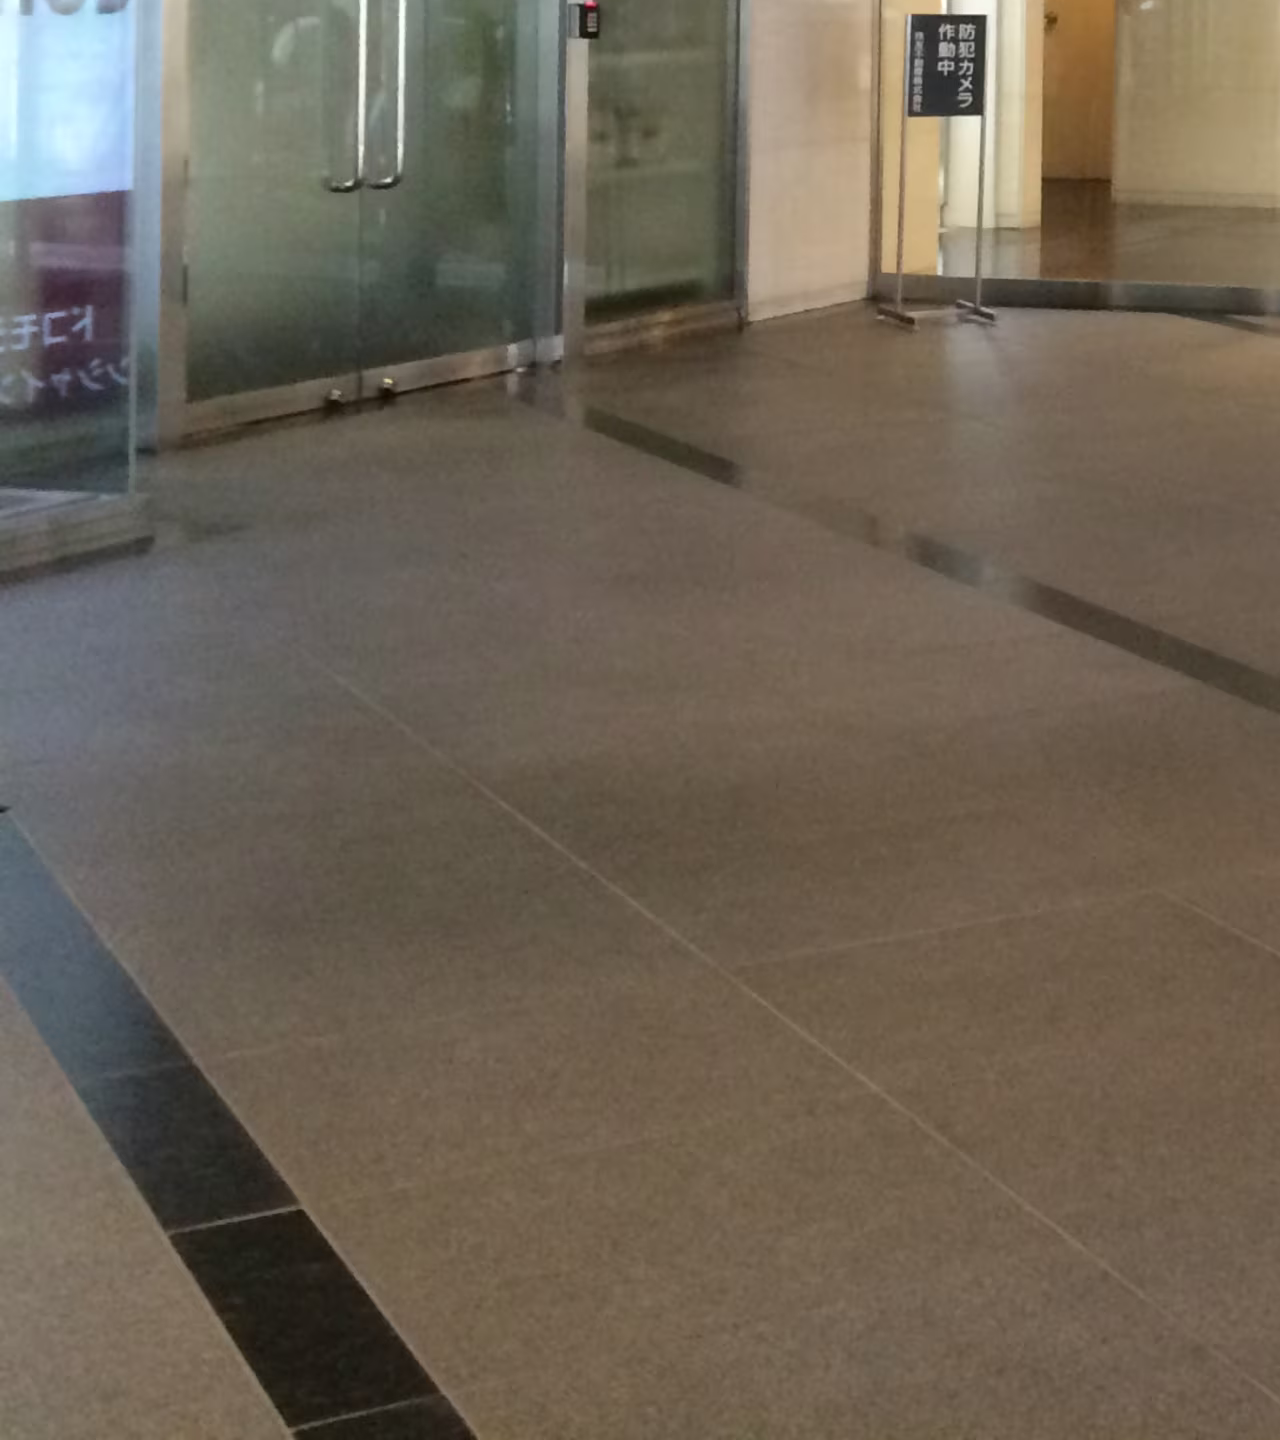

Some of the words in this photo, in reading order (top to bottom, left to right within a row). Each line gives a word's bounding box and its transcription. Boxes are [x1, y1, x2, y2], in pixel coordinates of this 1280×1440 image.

[937, 23, 956, 76] 作動中
[957, 23, 977, 108] 防犯カメラ
